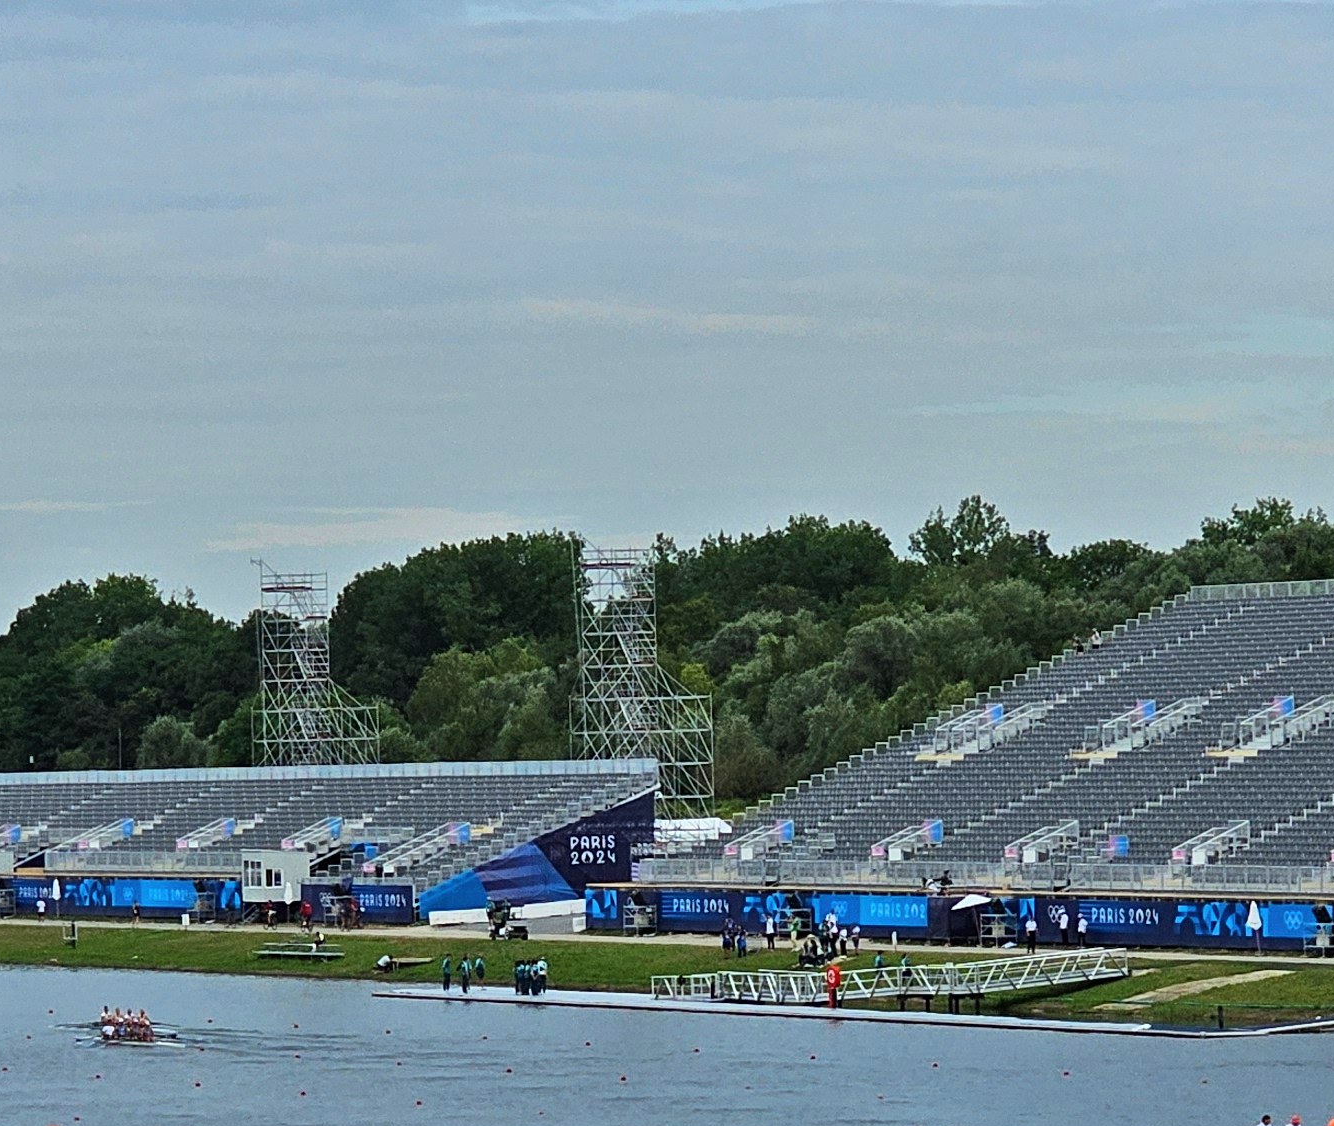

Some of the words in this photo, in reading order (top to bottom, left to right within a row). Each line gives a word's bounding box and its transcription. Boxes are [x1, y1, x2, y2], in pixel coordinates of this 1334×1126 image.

[570, 834, 615, 850] PARIS
[570, 850, 616, 865] 2024
[384, 894, 407, 907] 2024
[703, 898, 729, 913] 2024
[1128, 908, 1159, 925] 2024
